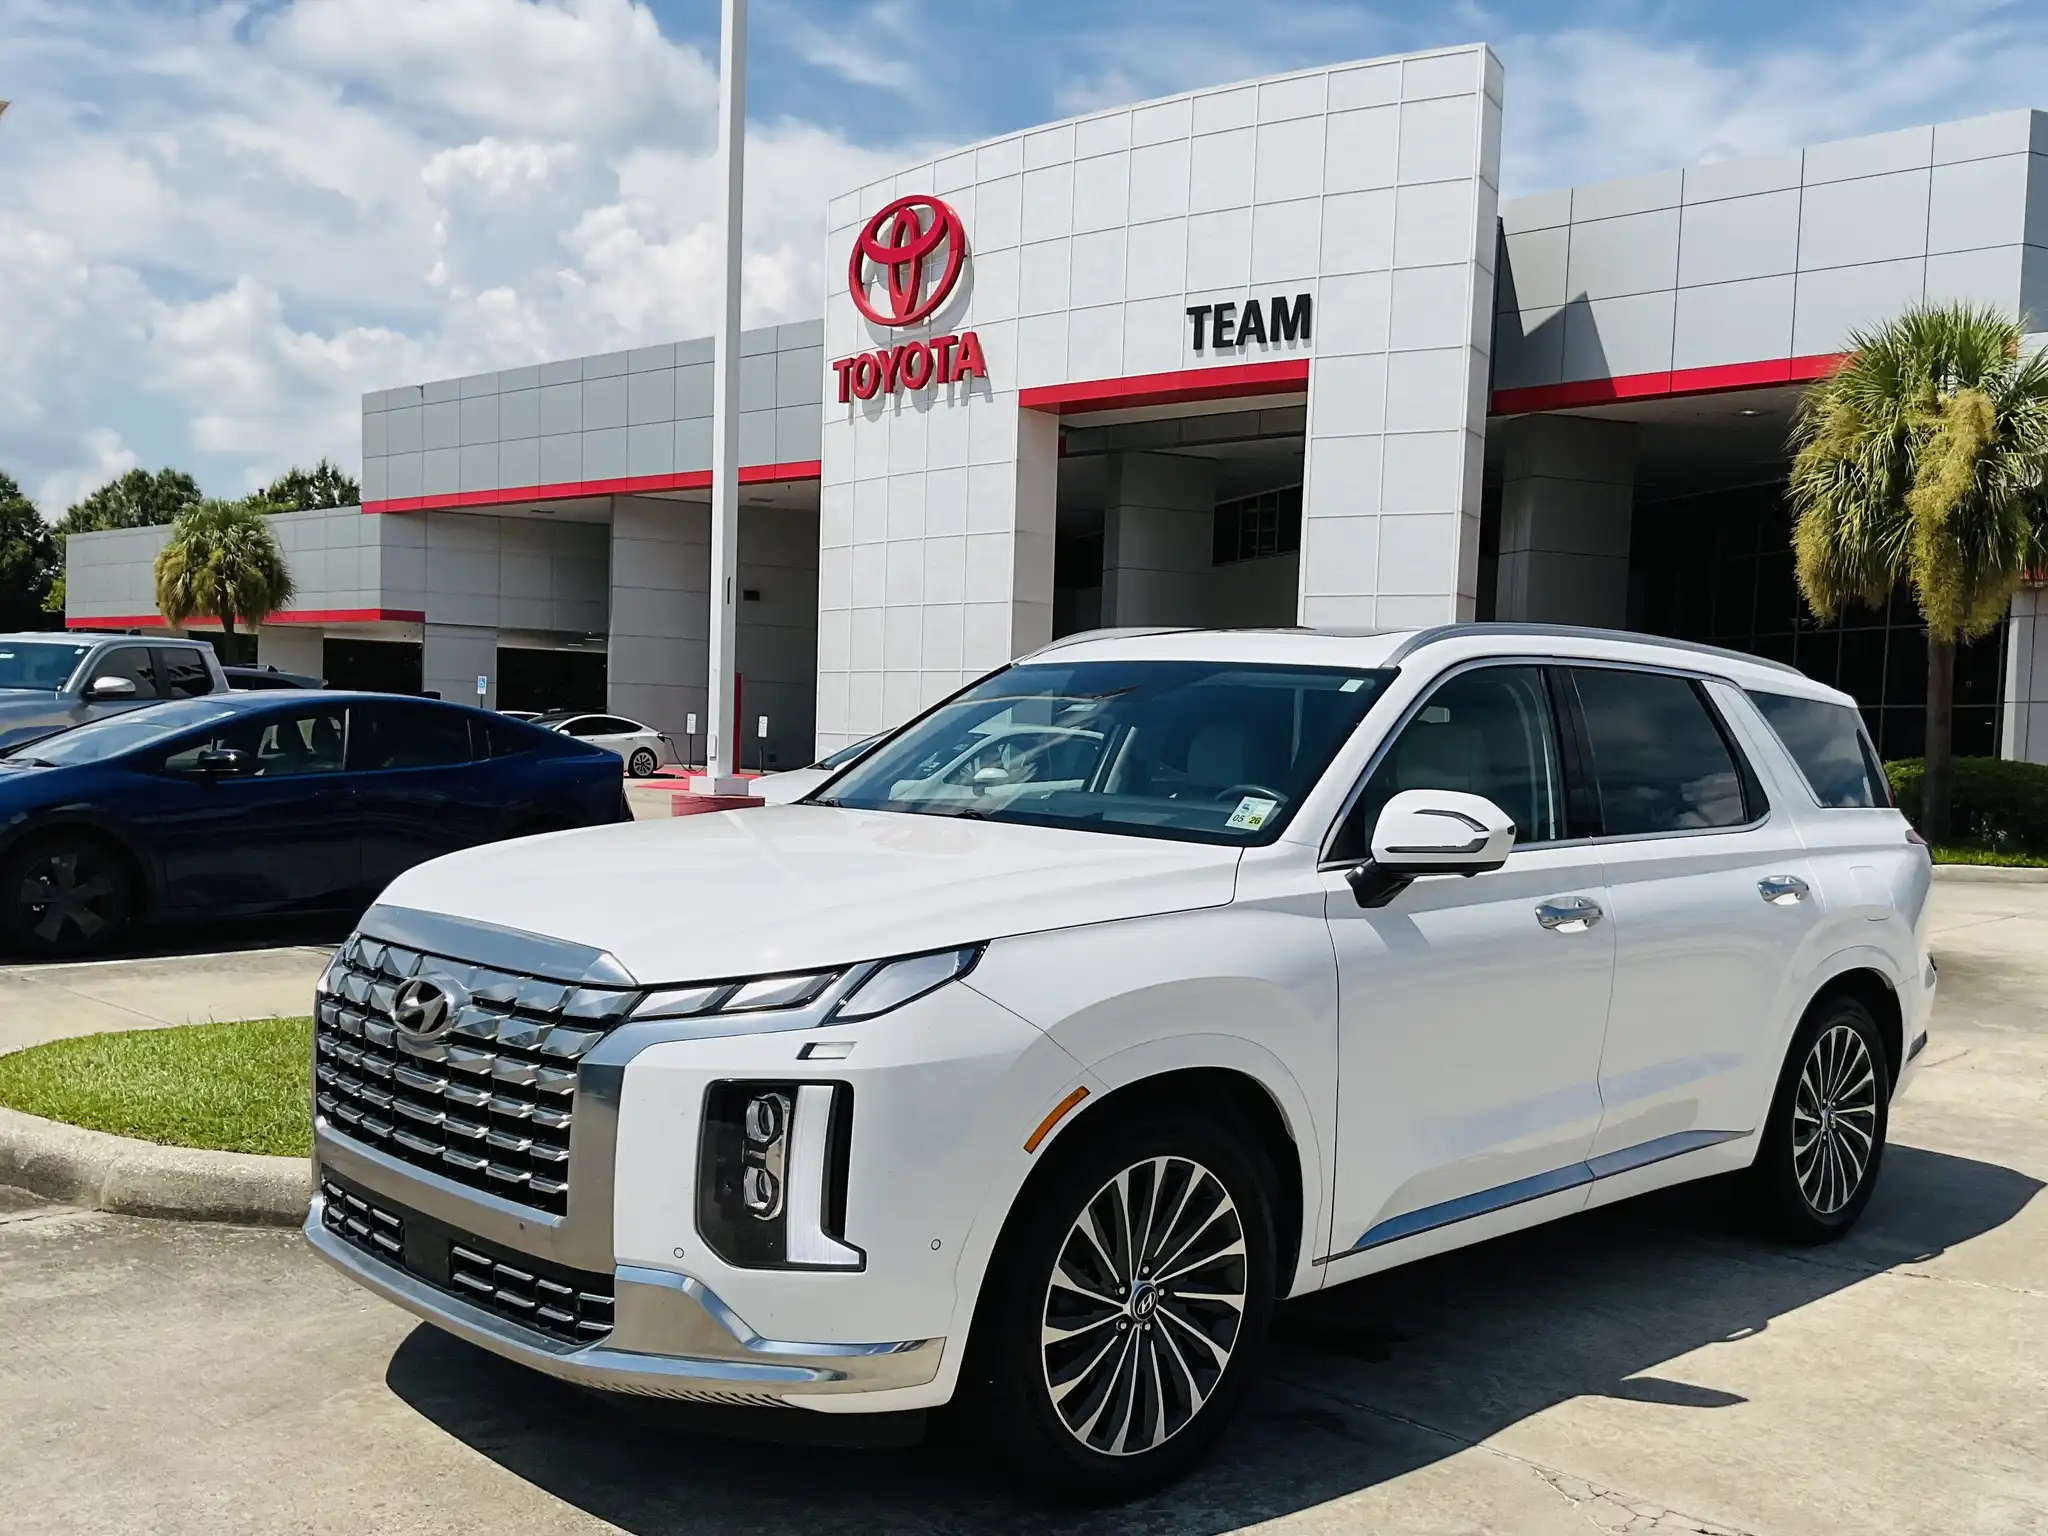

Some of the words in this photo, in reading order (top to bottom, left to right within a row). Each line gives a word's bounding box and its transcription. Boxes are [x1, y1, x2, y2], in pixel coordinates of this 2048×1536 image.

[1187, 293, 1312, 350] TEAM
[833, 331, 986, 404] TOYOTA
[1232, 814, 1245, 822] 05
[1248, 816, 1262, 824] 26
